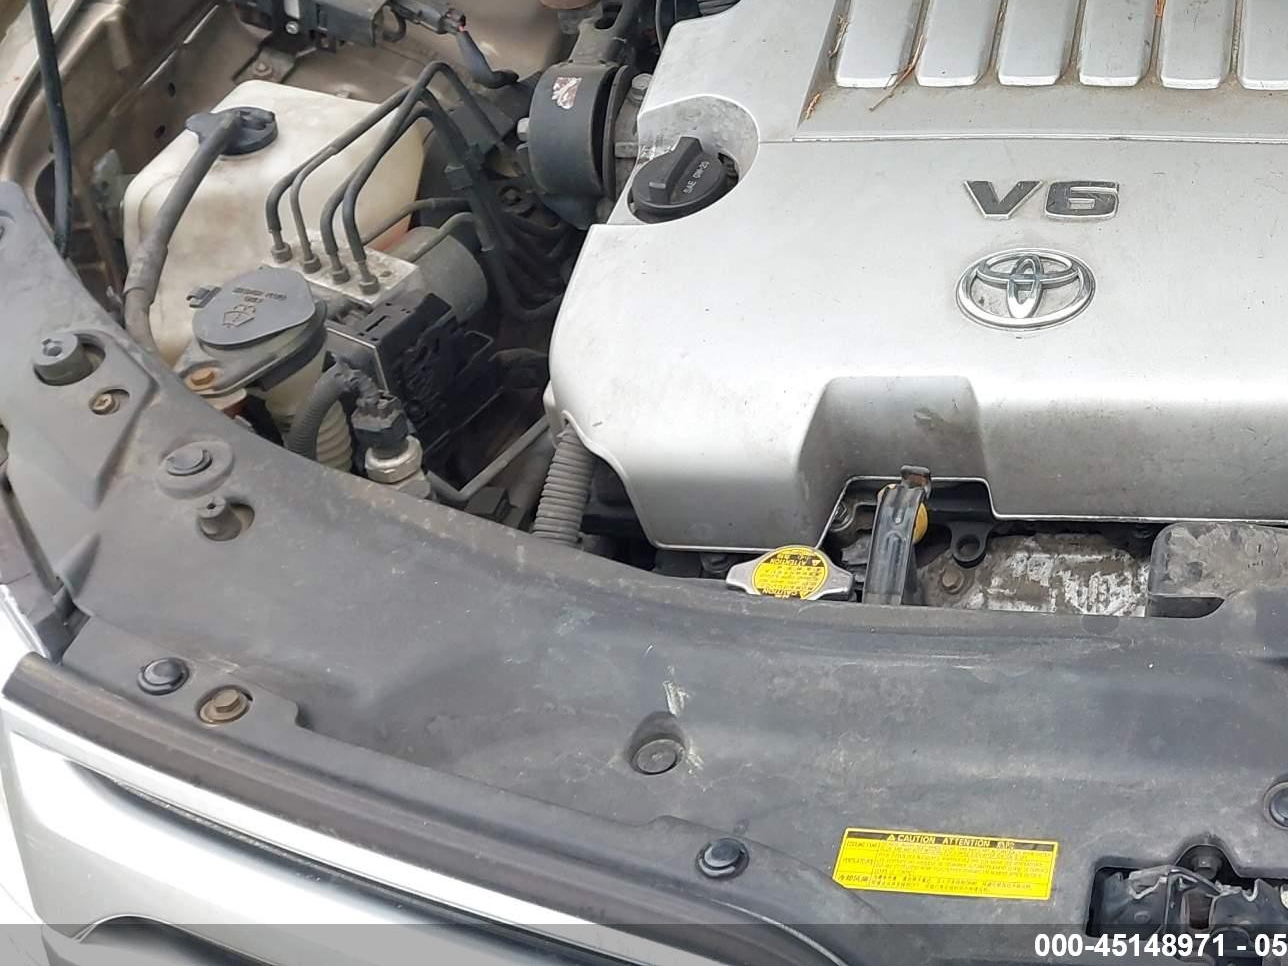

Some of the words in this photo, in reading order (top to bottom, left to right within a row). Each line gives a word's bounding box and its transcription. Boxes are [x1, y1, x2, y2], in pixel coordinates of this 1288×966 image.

[683, 180, 697, 194] SAE
[964, 180, 1120, 219] V6
[897, 834, 936, 845] CAUTION
[942, 836, 991, 847] ATTENTION
